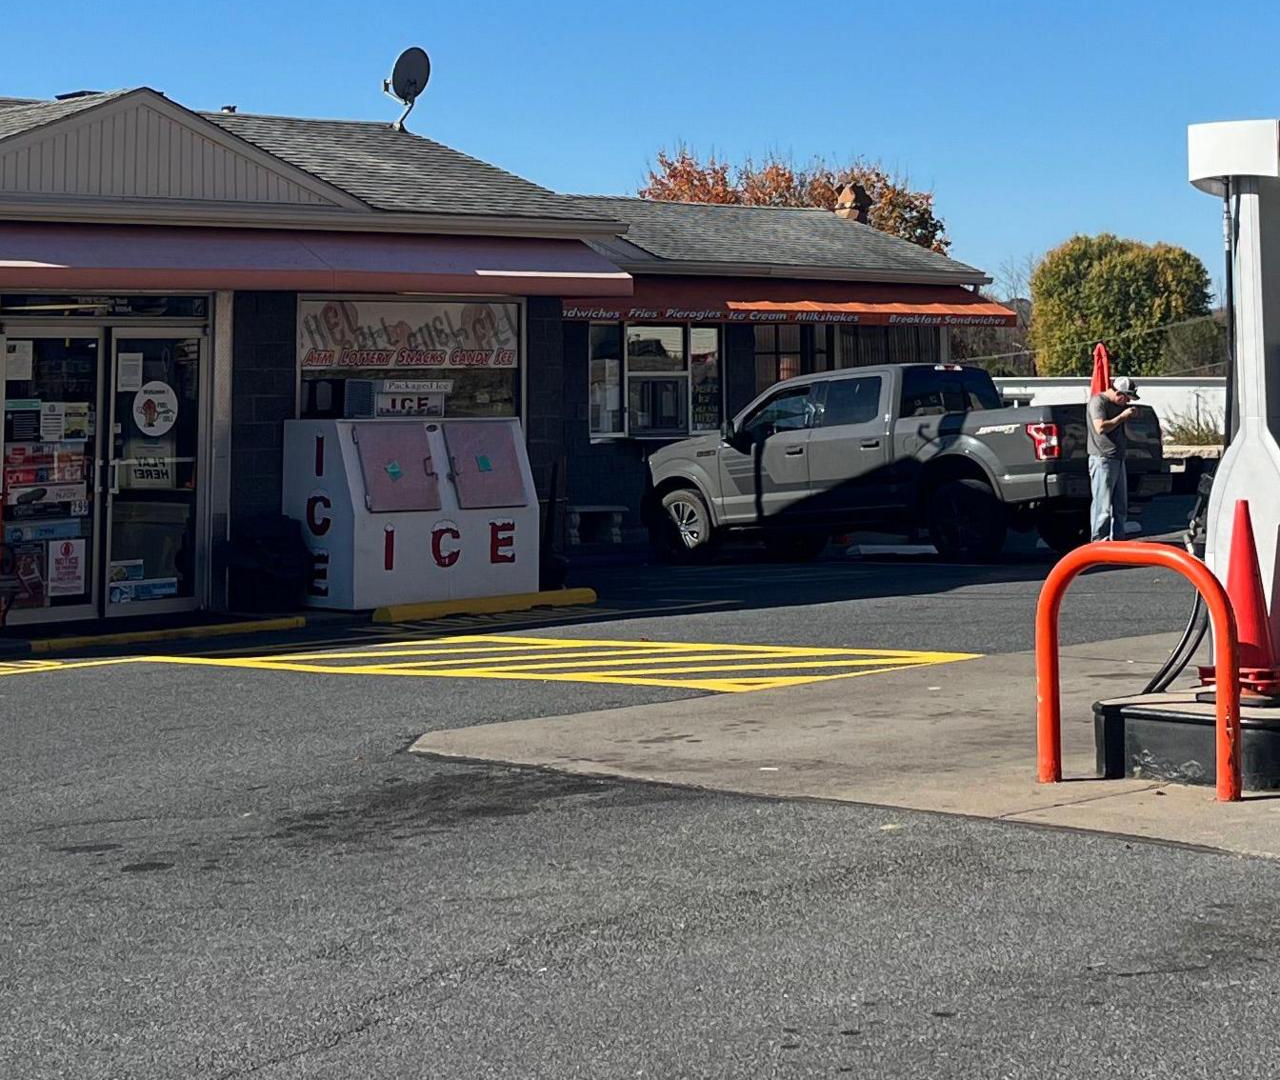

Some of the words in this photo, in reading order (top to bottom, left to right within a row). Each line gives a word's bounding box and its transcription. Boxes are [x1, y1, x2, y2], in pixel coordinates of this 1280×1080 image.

[628, 307, 658, 318] Fries
[665, 308, 722, 321] Pierogies
[729, 311, 746, 321] Ice
[748, 312, 788, 321] Cream
[795, 312, 860, 322] Milkshakes
[889, 314, 942, 325] Breakfast
[943, 315, 1007, 326] Sandwiches
[338, 348, 395, 366] LOTTERY
[395, 348, 447, 366] SNACKS
[448, 348, 493, 366] CANDY
[494, 348, 515, 366] ICE
[391, 397, 430, 409] ICE
[306, 432, 331, 597] ICE
[384, 521, 516, 571] ICE
